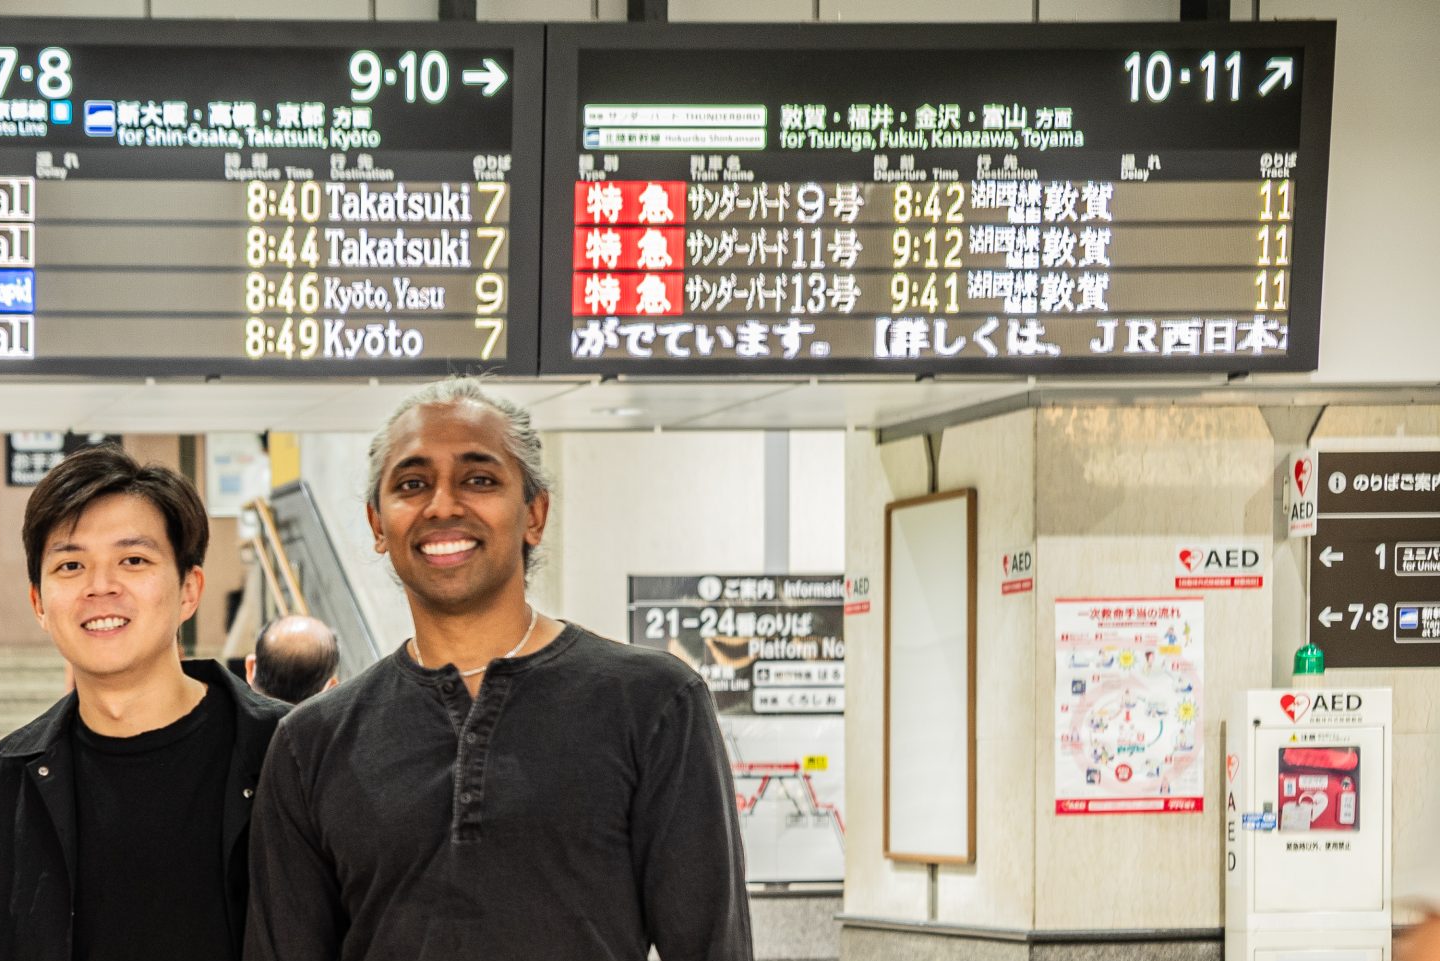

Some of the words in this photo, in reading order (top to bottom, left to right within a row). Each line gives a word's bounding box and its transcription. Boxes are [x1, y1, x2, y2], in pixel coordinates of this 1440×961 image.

[332, 106, 373, 130] 方面
[780, 102, 1027, 130] 敦賀・福井・金沢・富山
[1035, 107, 1073, 129] 方面
[118, 126, 143, 146] for
[245, 126, 328, 149] Takatsuki,
[330, 127, 381, 150] Kyōto
[780, 129, 806, 149] for
[808, 129, 877, 152] Tsuruga,
[879, 129, 929, 151] Fukui,
[930, 129, 1019, 150] Kanazawa,
[1022, 128, 1085, 150] Toyama
[285, 167, 315, 180] Time
[691, 169, 719, 181] Train
[722, 169, 755, 181] Name
[873, 168, 927, 182] Departure
[931, 168, 960, 181] Time
[247, 180, 321, 223] 8:40
[325, 183, 473, 222] Takatsuki
[477, 181, 507, 223] 7
[586, 182, 675, 223] 特急
[892, 182, 965, 223] 8:42
[1259, 178, 1291, 220] 11
[247, 226, 320, 269] 8:44
[325, 228, 472, 268] Takatsuki
[476, 227, 506, 269] 7
[585, 227, 674, 269] 特急
[891, 227, 963, 269] 9:12
[1257, 223, 1289, 266] 11
[245, 272, 319, 313] 8:46
[475, 273, 504, 314] 9
[584, 272, 673, 314] 特急
[890, 272, 960, 315] 9:41
[1255, 268, 1287, 311] 11
[245, 317, 319, 360] 8:49
[323, 319, 424, 360] Kyōto
[474, 318, 504, 360] 7
[572, 316, 832, 358] がでています。
[1291, 501, 1314, 520] AED
[1011, 550, 1032, 573] AED
[1204, 548, 1260, 569] AED
[1375, 542, 1386, 570] 1
[1402, 560, 1415, 572] for
[723, 579, 776, 600] ご案内
[853, 578, 870, 595] AED
[748, 639, 818, 660] Platform
[1311, 694, 1363, 712] AED
